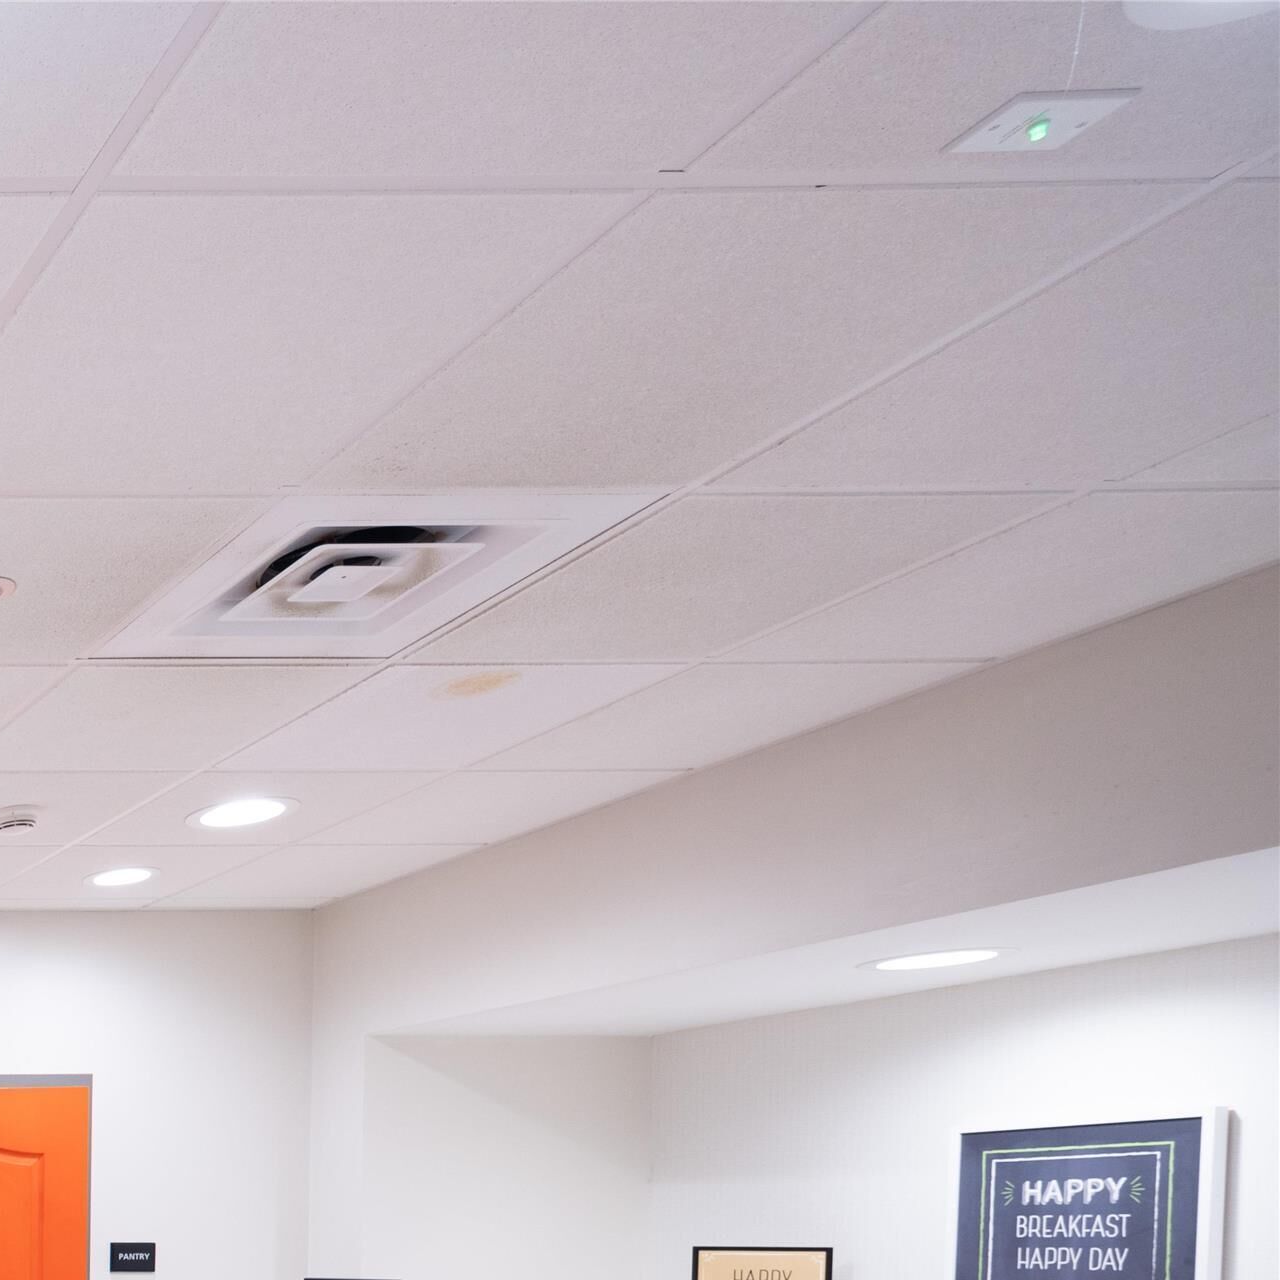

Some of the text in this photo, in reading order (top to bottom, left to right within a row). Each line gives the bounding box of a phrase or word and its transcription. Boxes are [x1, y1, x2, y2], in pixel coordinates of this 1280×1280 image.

[1021, 1177, 1127, 1206] HAPPY
[1016, 1214, 1131, 1238] BREAKFAST
[1017, 1247, 1129, 1271] HAPPY DAY
